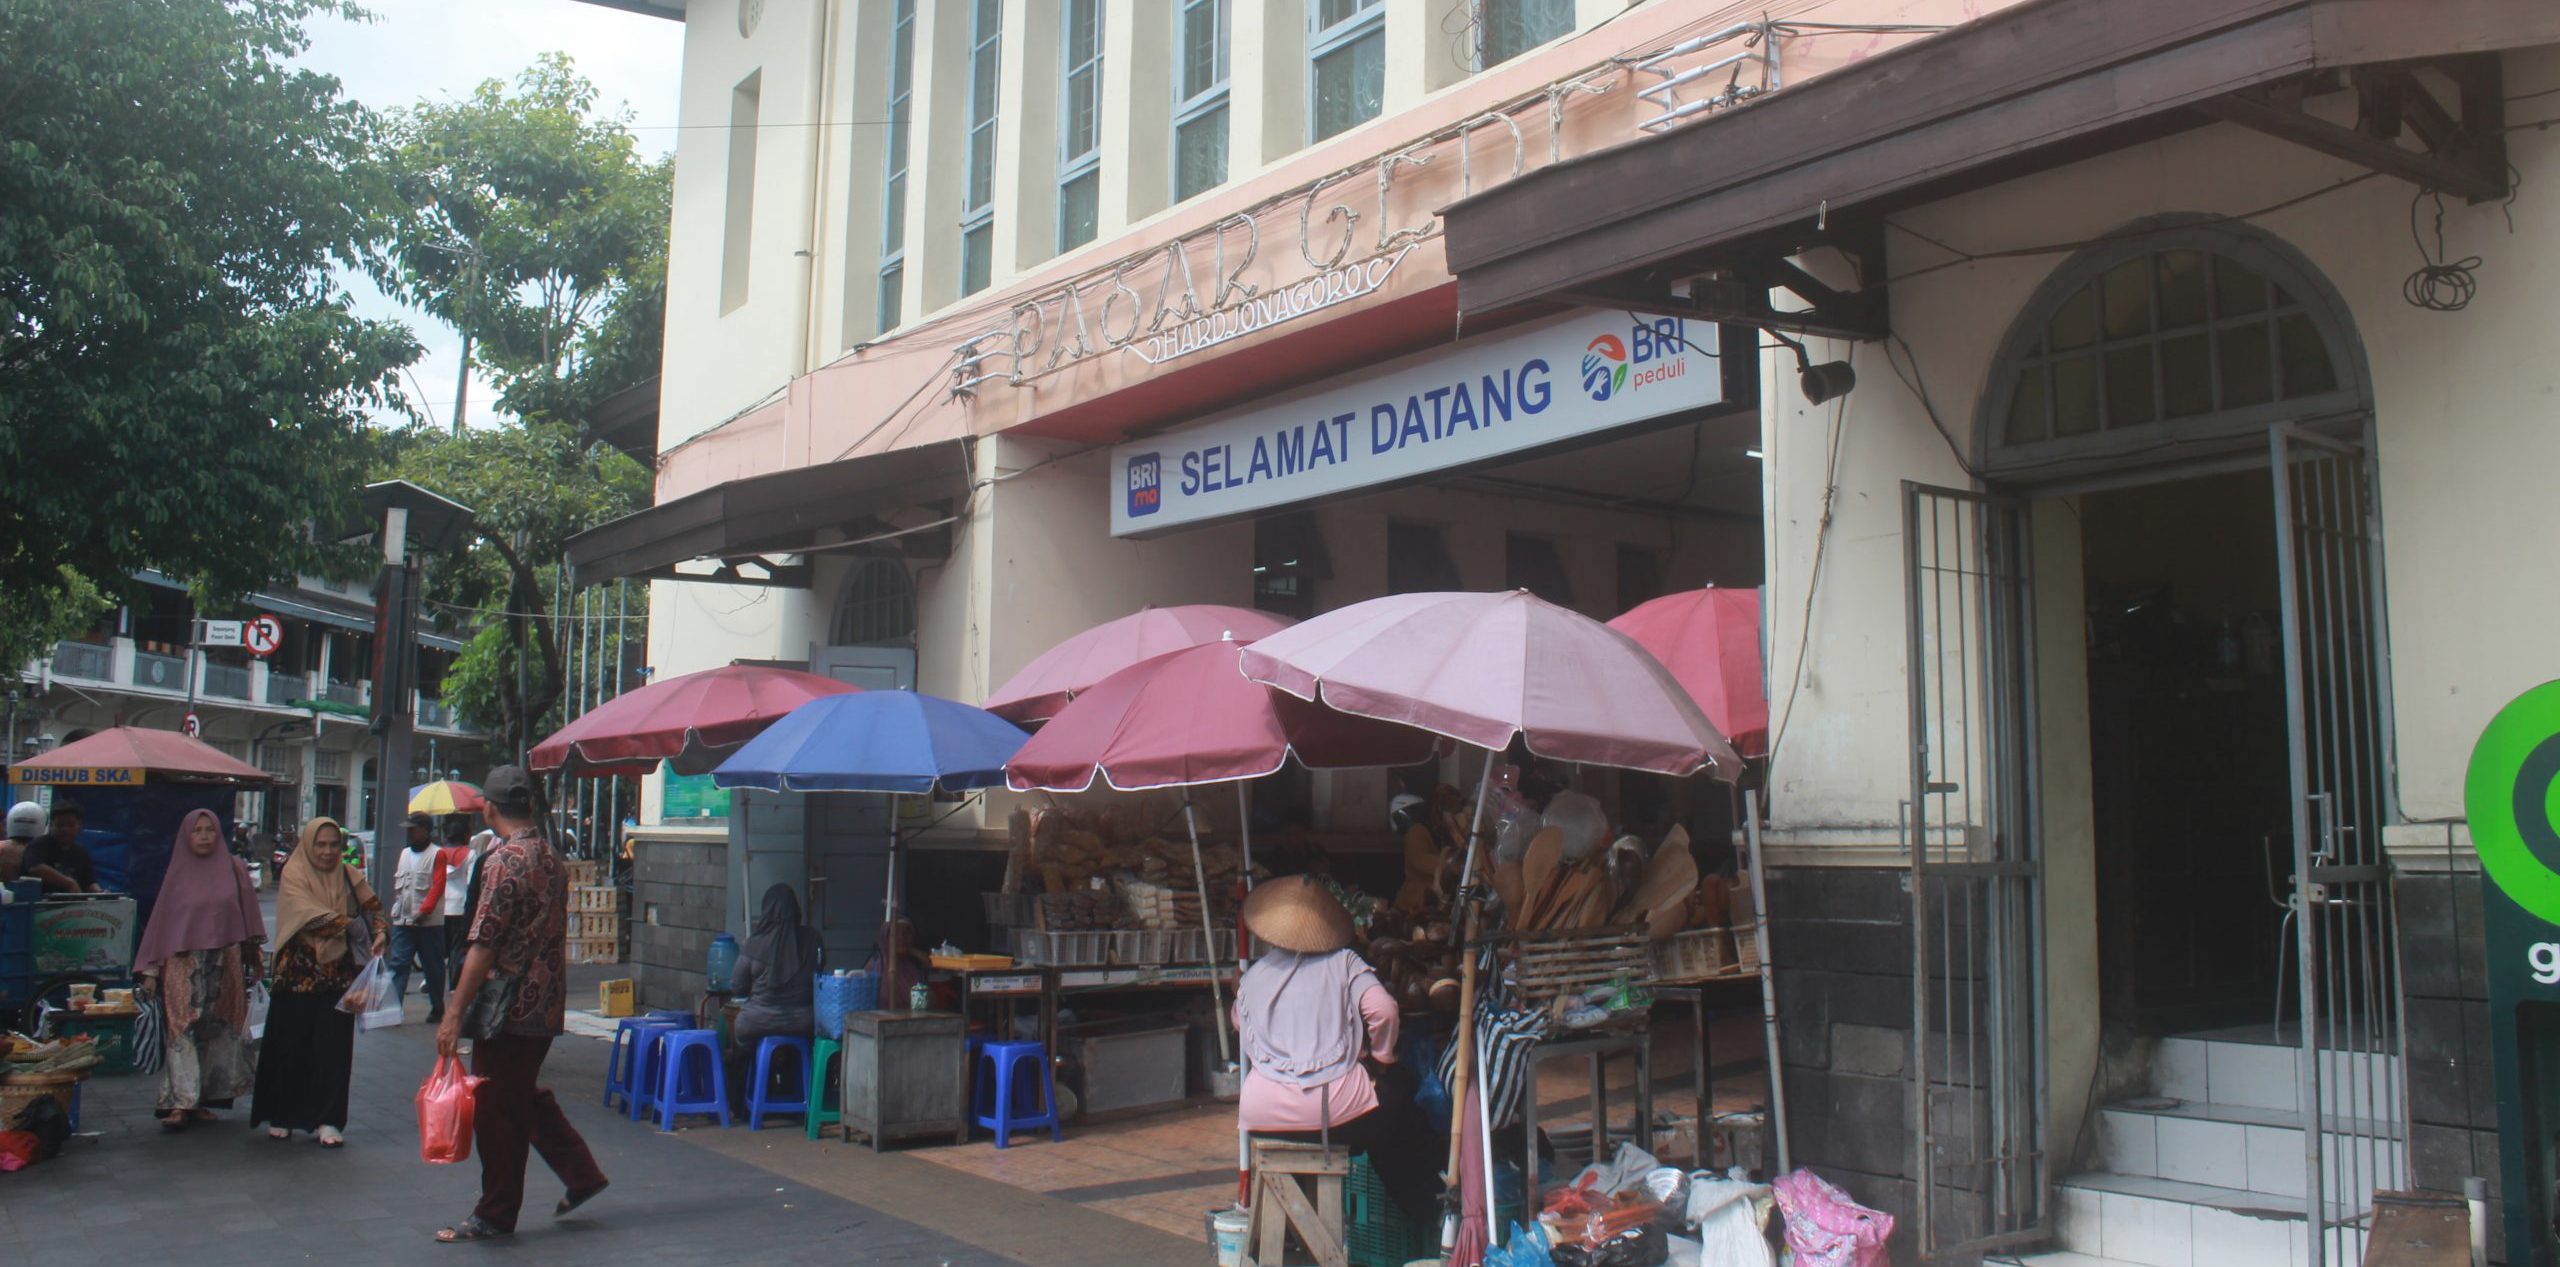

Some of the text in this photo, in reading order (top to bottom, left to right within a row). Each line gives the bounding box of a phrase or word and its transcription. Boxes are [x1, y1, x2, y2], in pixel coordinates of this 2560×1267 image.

[1010, 213, 1258, 386] PASAR
[1632, 317, 1684, 364] BRI
[1633, 358, 1685, 391] peduli
[1180, 358, 1552, 496] SELAMAT DATANG
[1130, 461, 1157, 490] BRI
[1135, 489, 1157, 507] mo
[21, 769, 131, 783] DISHUB SKA
